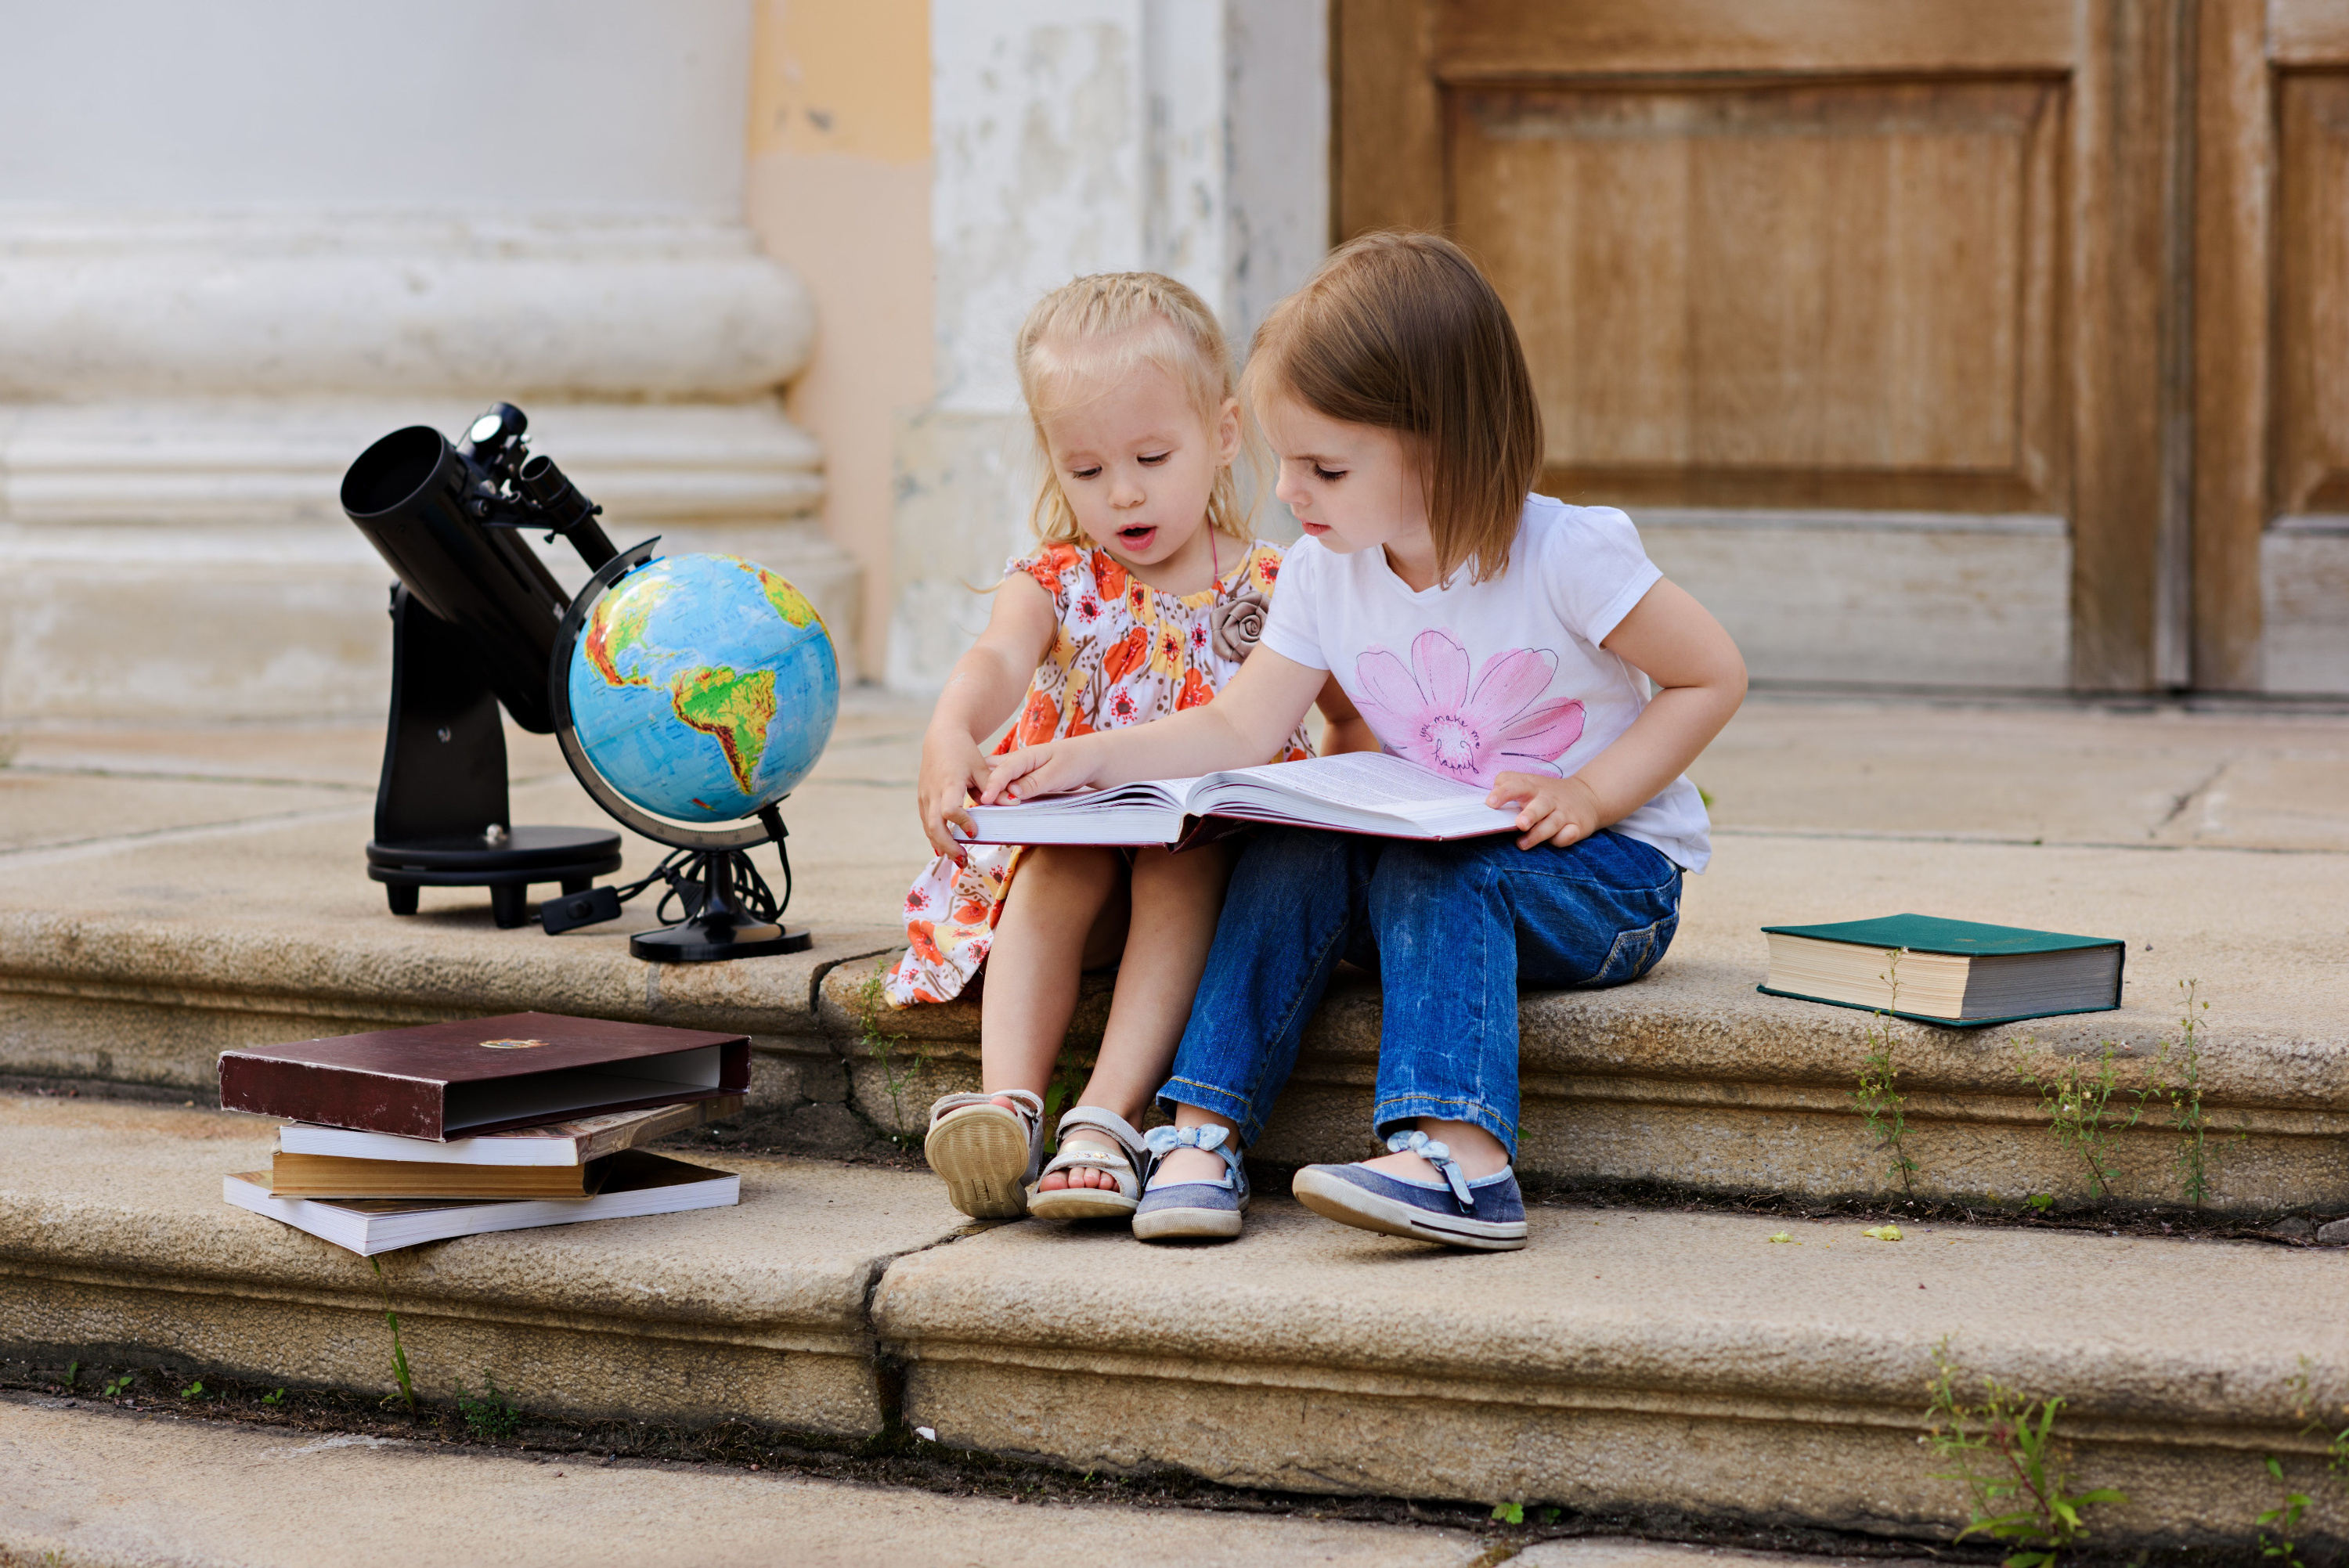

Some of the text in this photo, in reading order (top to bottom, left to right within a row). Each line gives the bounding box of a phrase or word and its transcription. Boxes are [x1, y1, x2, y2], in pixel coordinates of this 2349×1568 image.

[1420, 714, 1480, 749] you make me
[1431, 738, 1479, 776] happy
